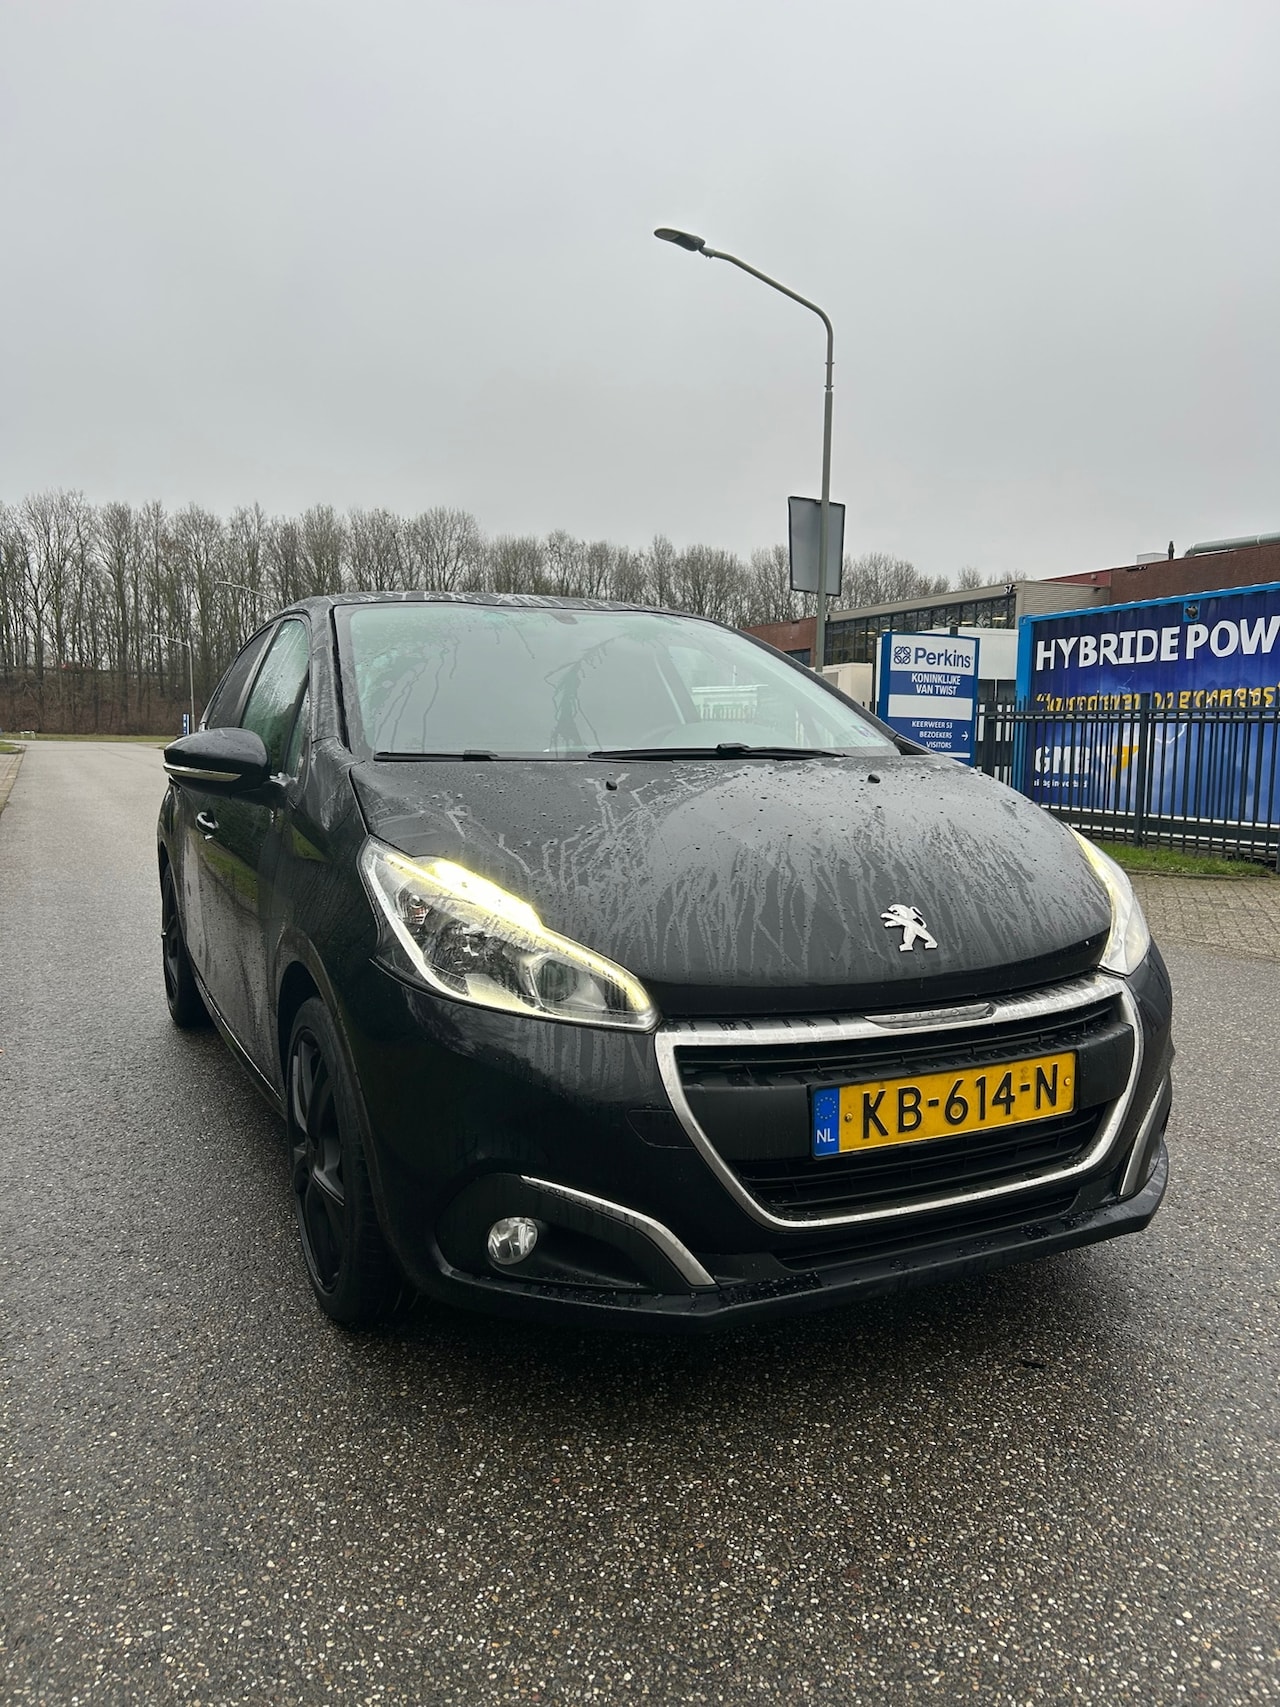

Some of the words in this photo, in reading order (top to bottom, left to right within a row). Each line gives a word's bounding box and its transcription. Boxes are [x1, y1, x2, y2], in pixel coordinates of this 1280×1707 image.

[1035, 625, 1181, 671] HYBRIDE
[1185, 615, 1280, 660] POW
[914, 647, 971, 669] Perkins
[911, 673, 961, 685] KONINKLIJKE
[916, 684, 934, 694] VAN
[935, 685, 957, 695] TWIST
[911, 720, 946, 729] KEERWEER
[919, 731, 953, 740] BEZOEKERS
[926, 741, 952, 749] VISITORS
[862, 1063, 1059, 1139] KB-614-N
[816, 1128, 835, 1144] NL
